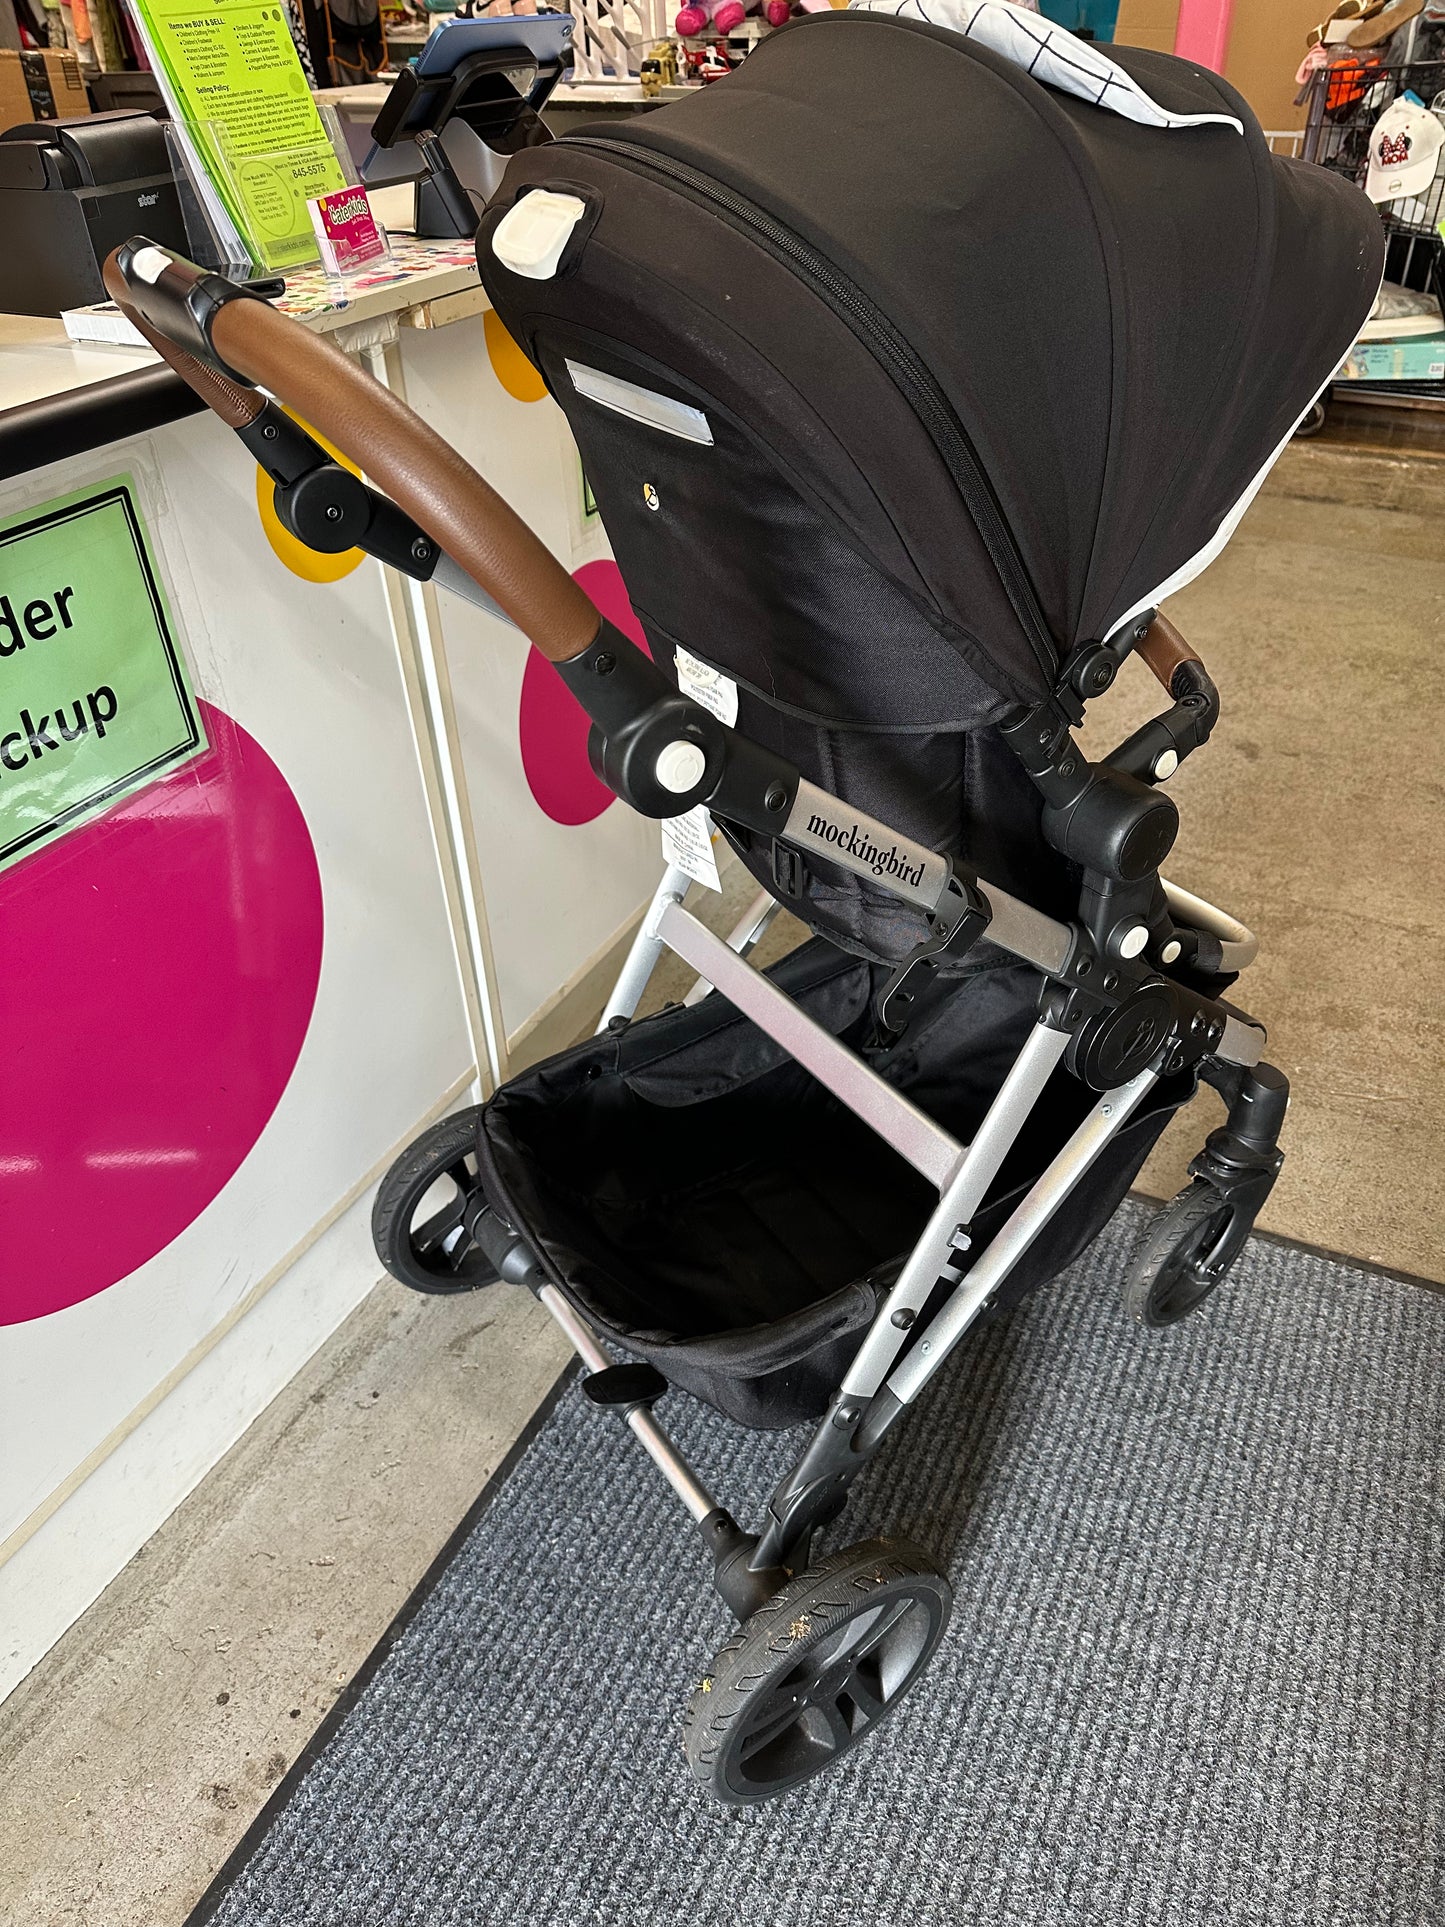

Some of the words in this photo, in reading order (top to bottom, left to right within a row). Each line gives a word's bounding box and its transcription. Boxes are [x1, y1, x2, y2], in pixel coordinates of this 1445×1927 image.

[168, 21, 184, 30] Items
[192, 19, 204, 27] BUY
[196, 85, 214, 94] Selling
[213, 83, 231, 92] Policy:
[1381, 150, 1408, 166] MOM
[292, 163, 326, 178] 845-5575
[0, 586, 74, 657] der
[0, 685, 118, 776] ckup
[806, 814, 926, 888] mockingbird
